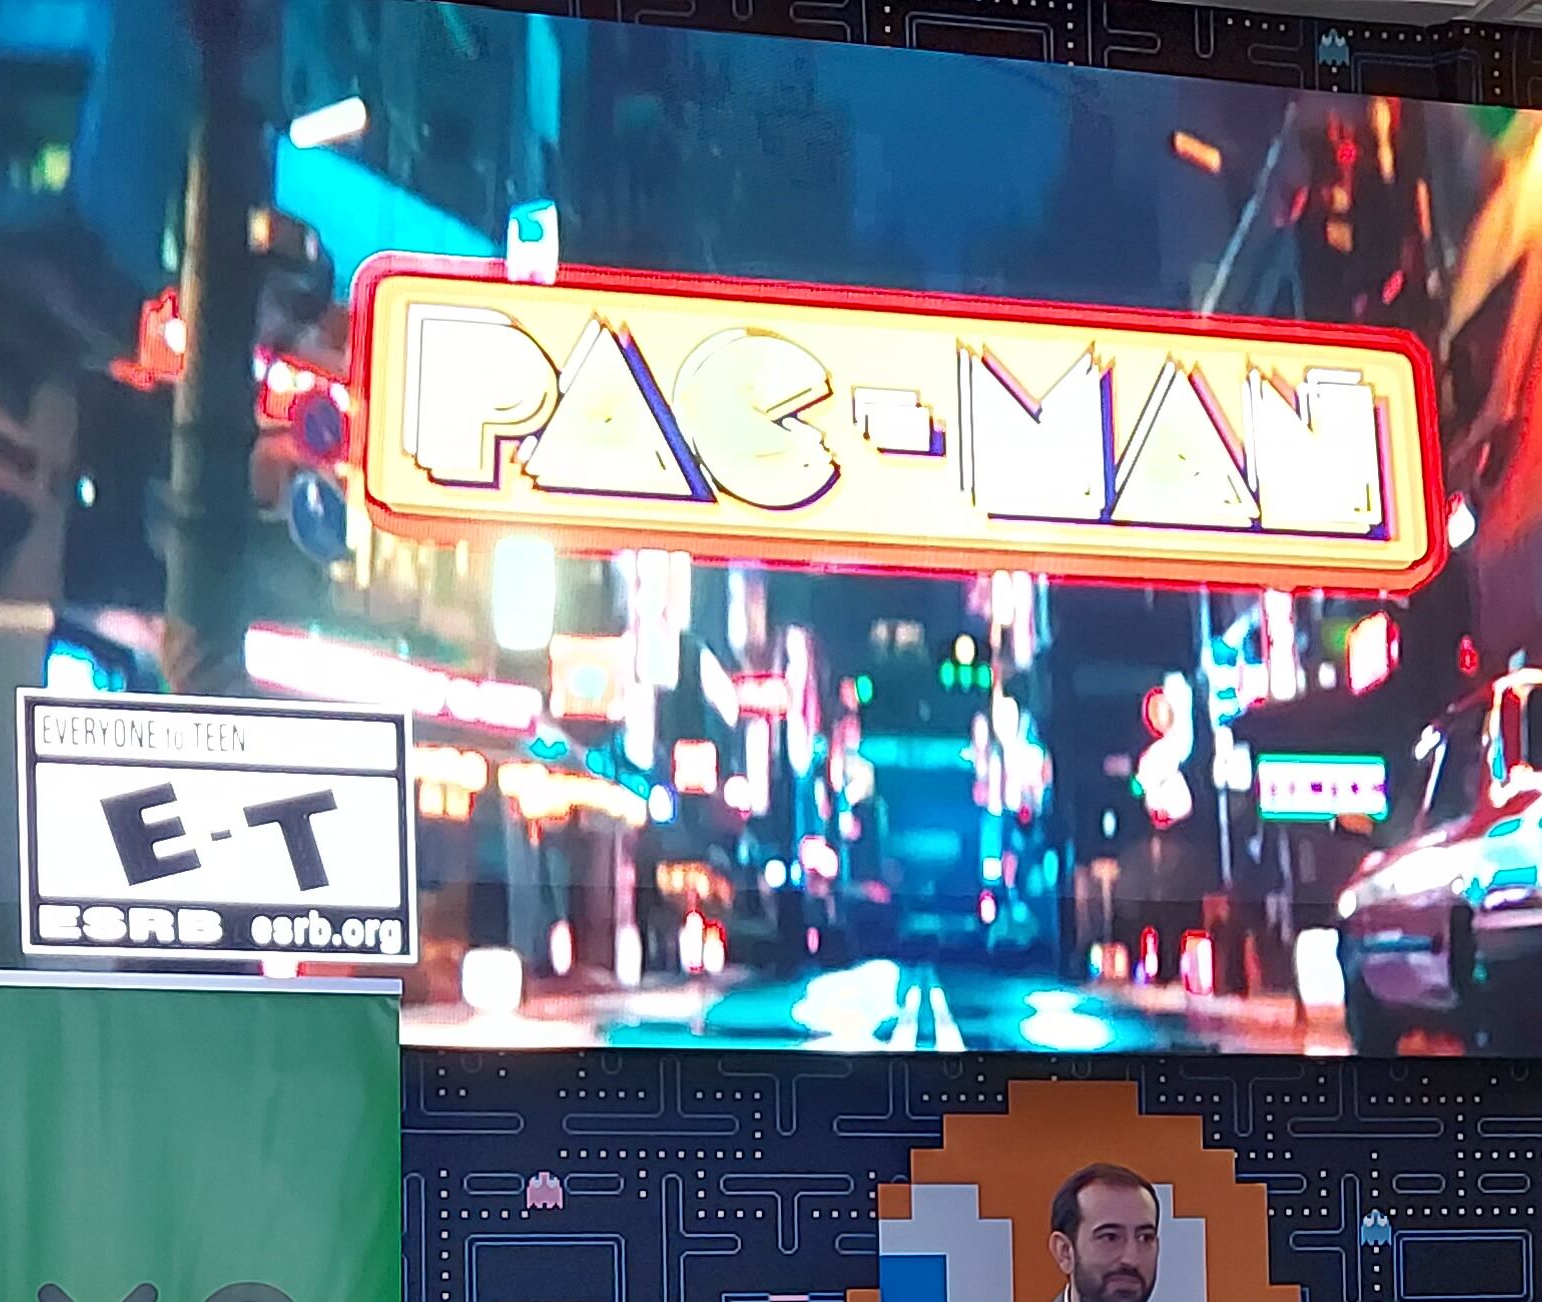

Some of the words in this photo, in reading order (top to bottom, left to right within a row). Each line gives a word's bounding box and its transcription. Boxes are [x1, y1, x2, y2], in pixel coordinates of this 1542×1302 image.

[405, 302, 1393, 541] PAC-MAN
[42, 714, 158, 749] EVERYONE
[193, 721, 246, 752] TEEN
[38, 903, 224, 945] ESRB
[250, 908, 403, 955] esrb.org
